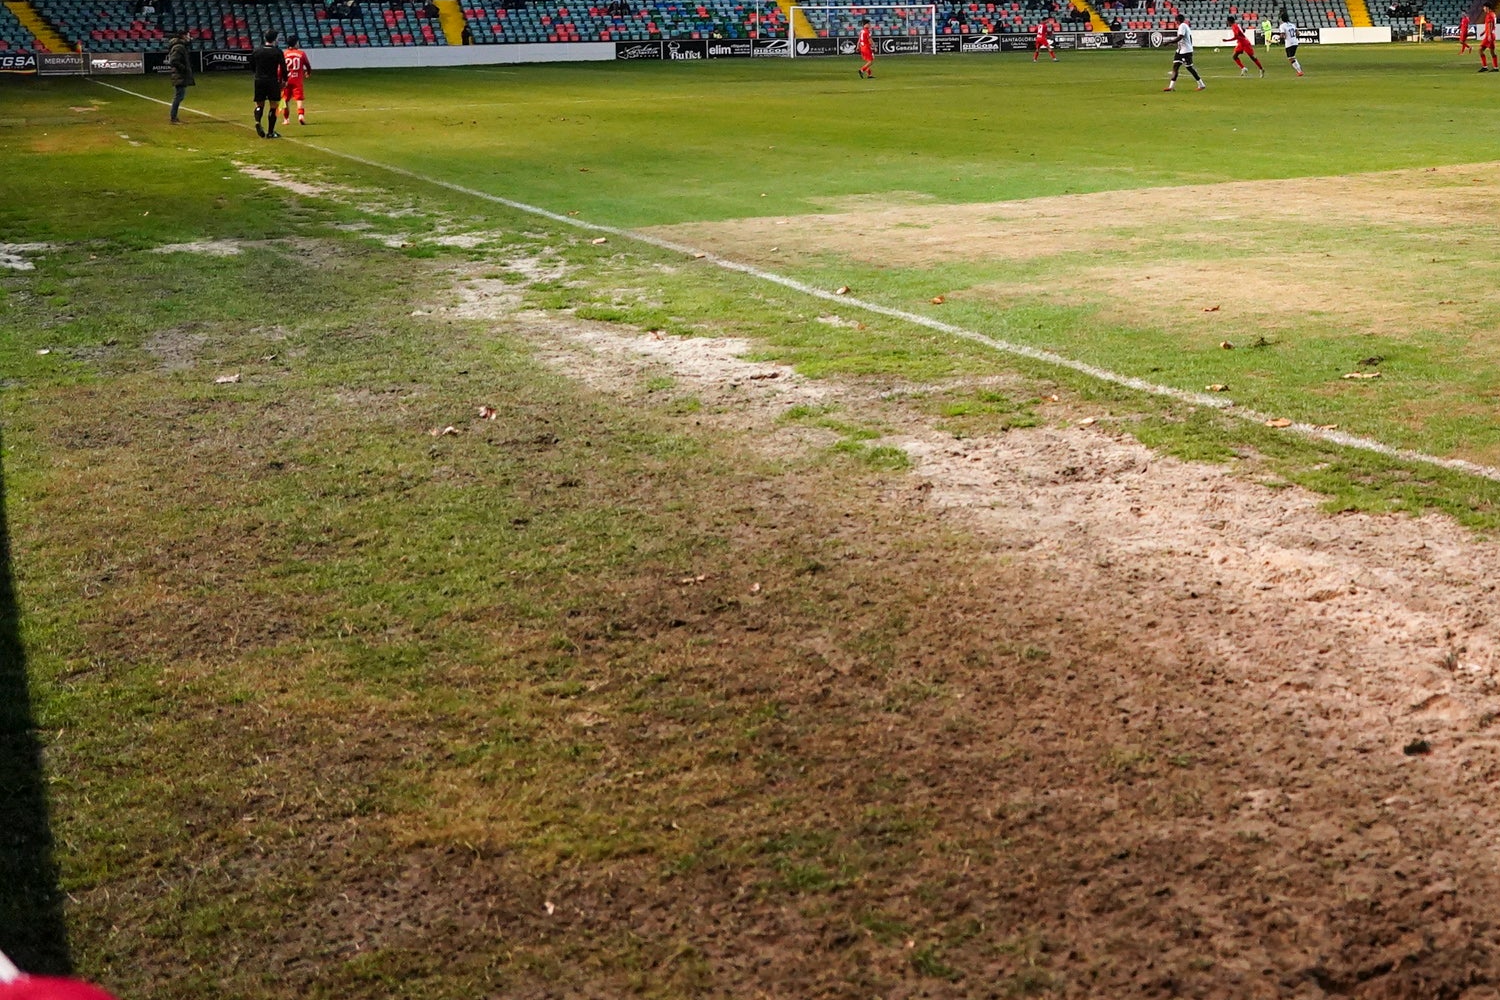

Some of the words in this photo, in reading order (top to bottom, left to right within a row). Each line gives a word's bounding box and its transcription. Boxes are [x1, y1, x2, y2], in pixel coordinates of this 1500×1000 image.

[671, 50, 702, 60] Buffet
[709, 44, 731, 56] elim
[0, 57, 36, 67] GSA
[212, 54, 248, 62] ALJOMAR
[285, 57, 301, 72] 20
